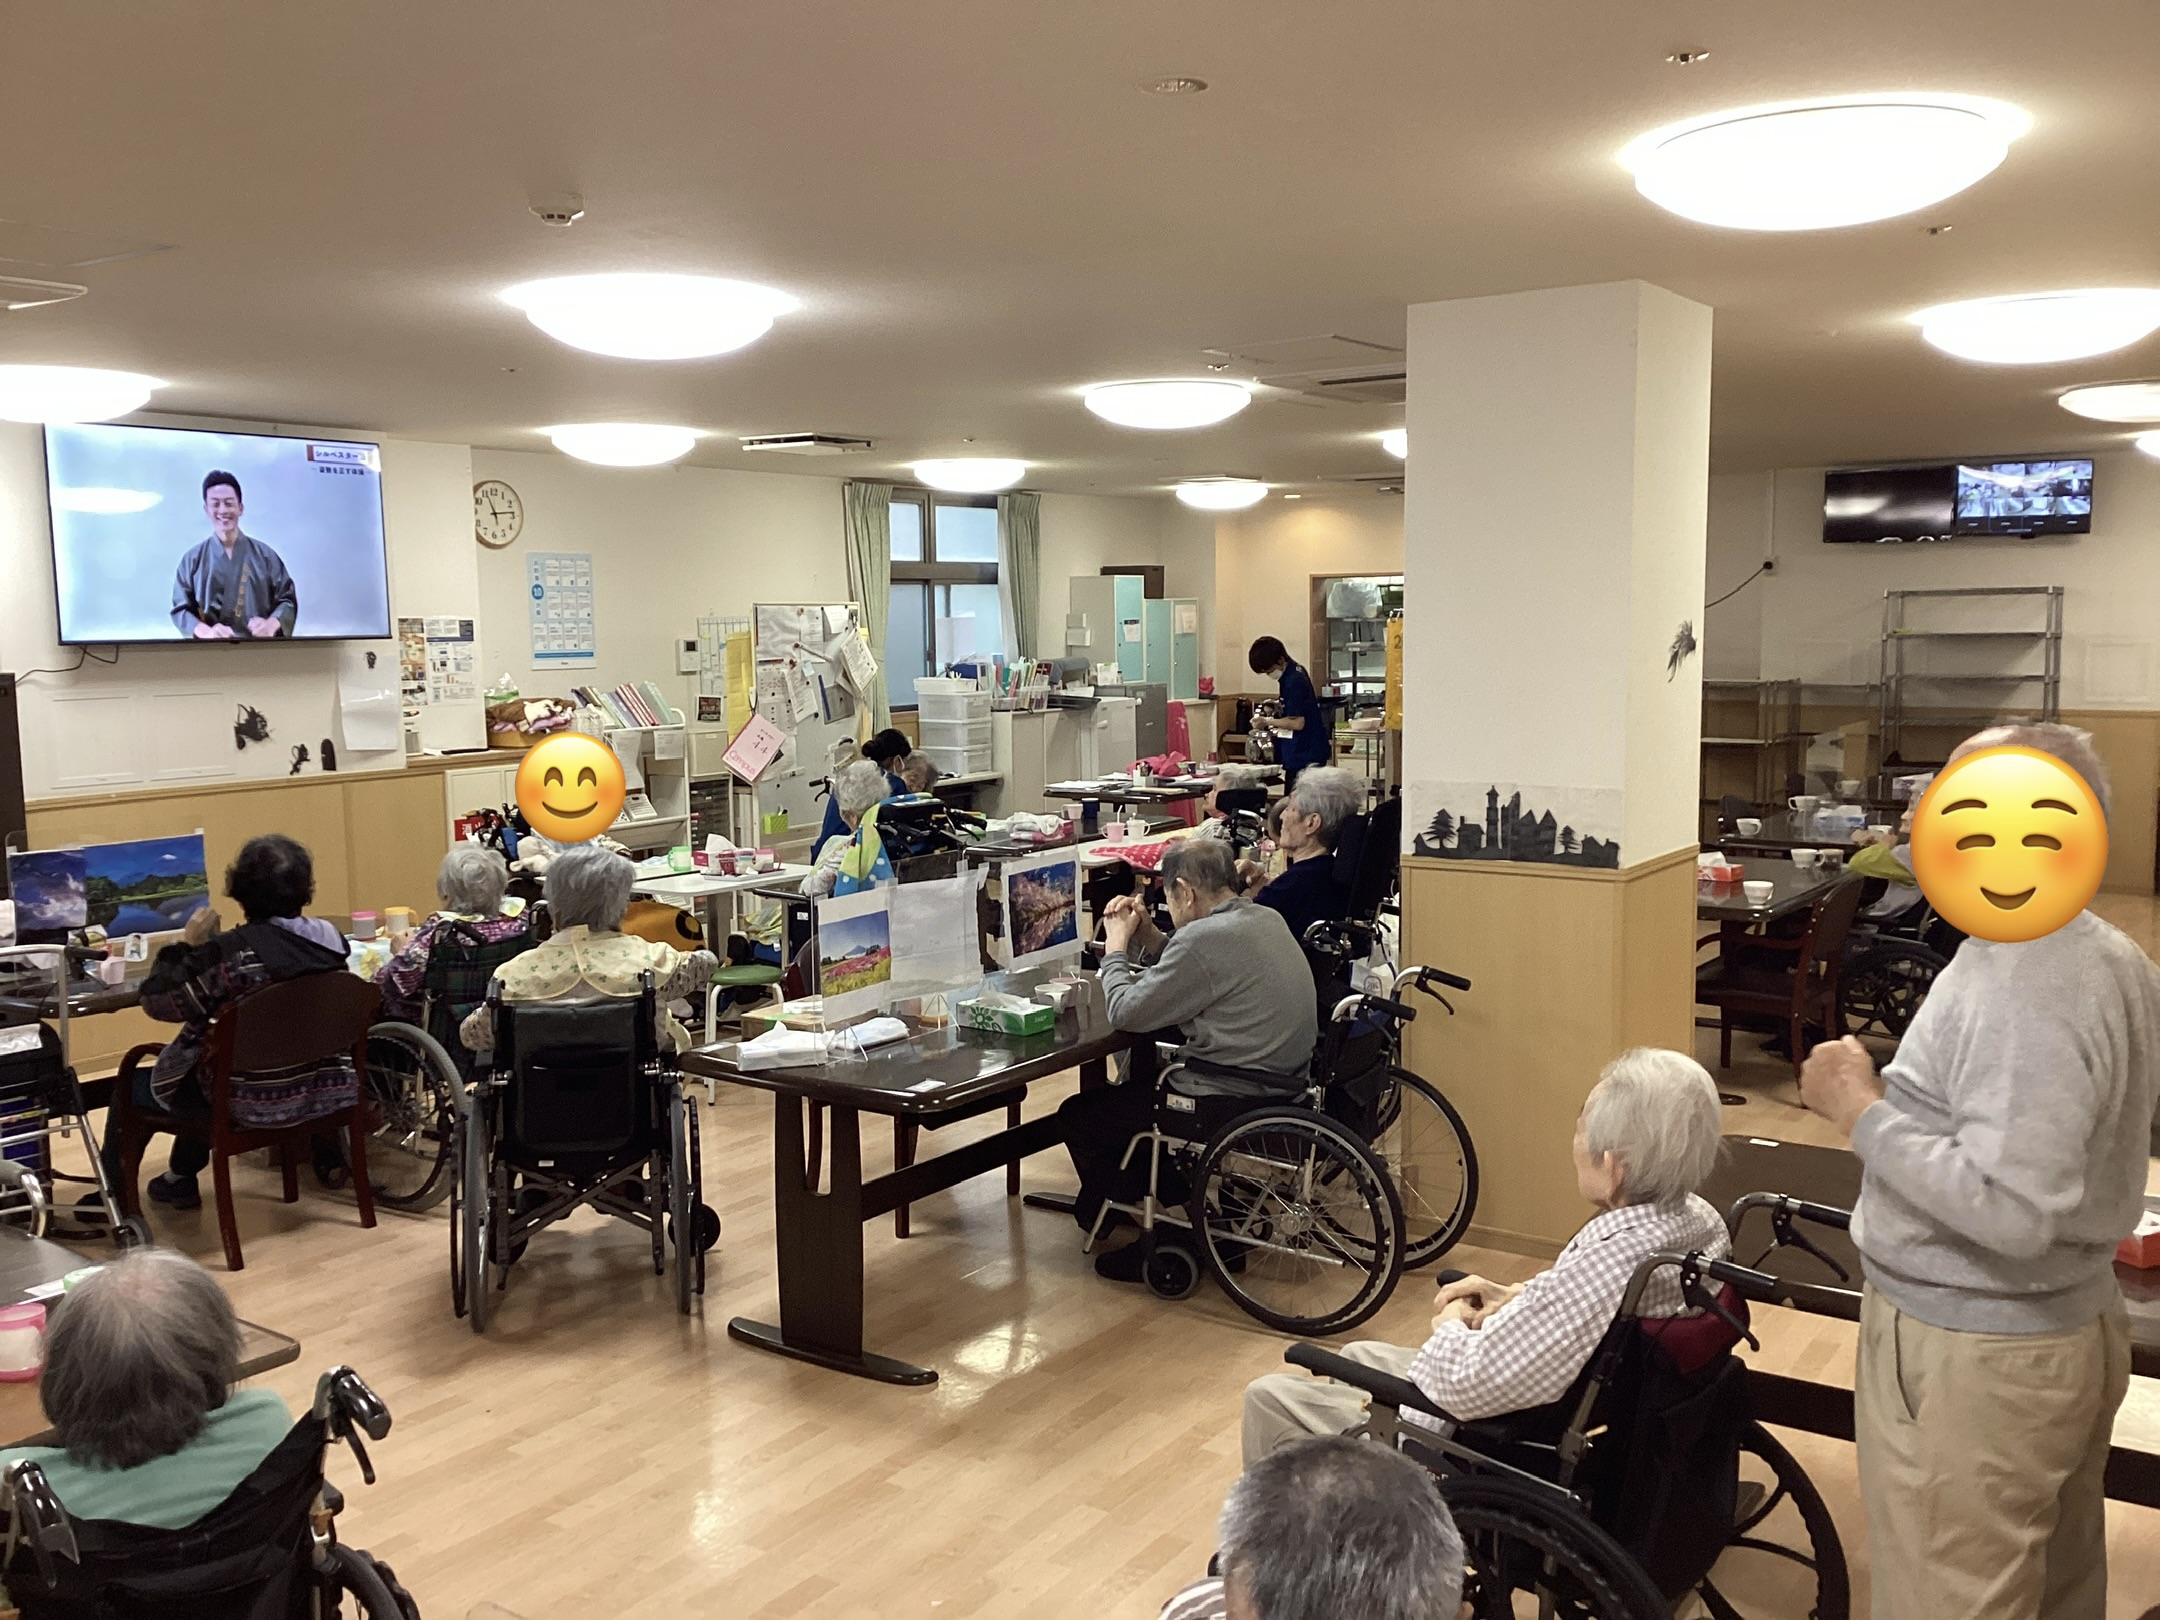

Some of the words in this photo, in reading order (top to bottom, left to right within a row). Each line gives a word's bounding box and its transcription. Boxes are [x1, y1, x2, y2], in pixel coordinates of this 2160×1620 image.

[482, 490, 488, 498] 11
[490, 488, 498, 496] 12
[507, 500, 513, 508] 2
[483, 527, 488, 536] 7
[491, 531, 497, 539] 6
[501, 529, 506, 538] 5
[729, 750, 756, 775] Campus
